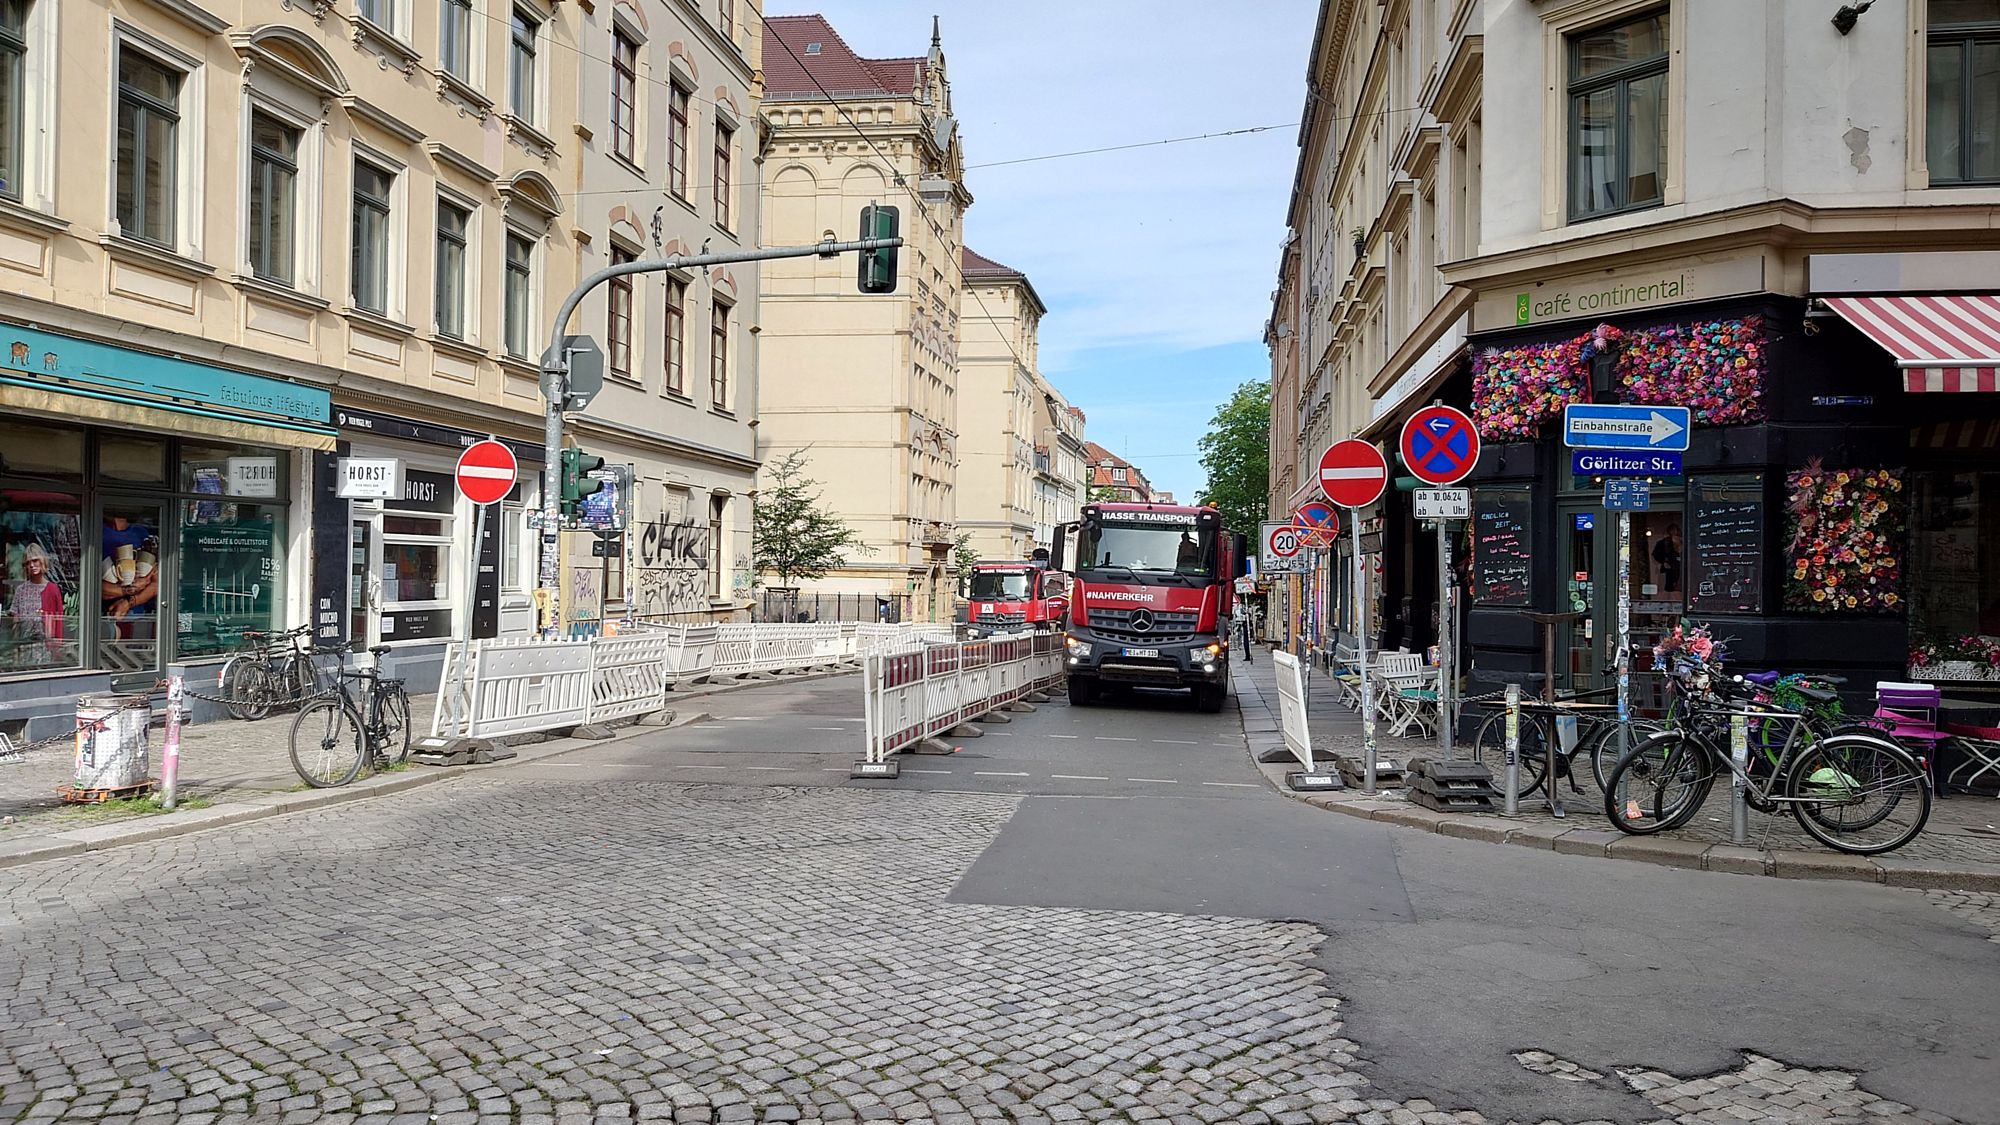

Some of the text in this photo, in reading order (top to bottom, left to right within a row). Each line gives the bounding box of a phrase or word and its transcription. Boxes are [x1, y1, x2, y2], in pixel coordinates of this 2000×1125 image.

[1534, 274, 1684, 317] café continental
[220, 385, 320, 418] fabulous lifestyle
[1573, 421, 1653, 432] Einbahnstraße
[1580, 456, 1676, 470] Görlitzer Str.
[349, 466, 386, 480] HORST
[406, 480, 435, 501] HORST
[1418, 492, 1462, 501] ab 10.06.24
[1418, 506, 1466, 515] ab 4 Uhr
[1102, 512, 1197, 524] HASSE TRANSPORT
[1495, 520, 1511, 529] ZEIT
[198, 537, 229, 545] MÖBELCAFÉ
[1277, 535, 1294, 550] 20
[261, 557, 280, 570] 15%
[261, 569, 280, 577] RABATT
[1086, 591, 1154, 602] #NAHVERKEHR
[320, 598, 330, 610] CON
[320, 611, 338, 624] MUCHO
